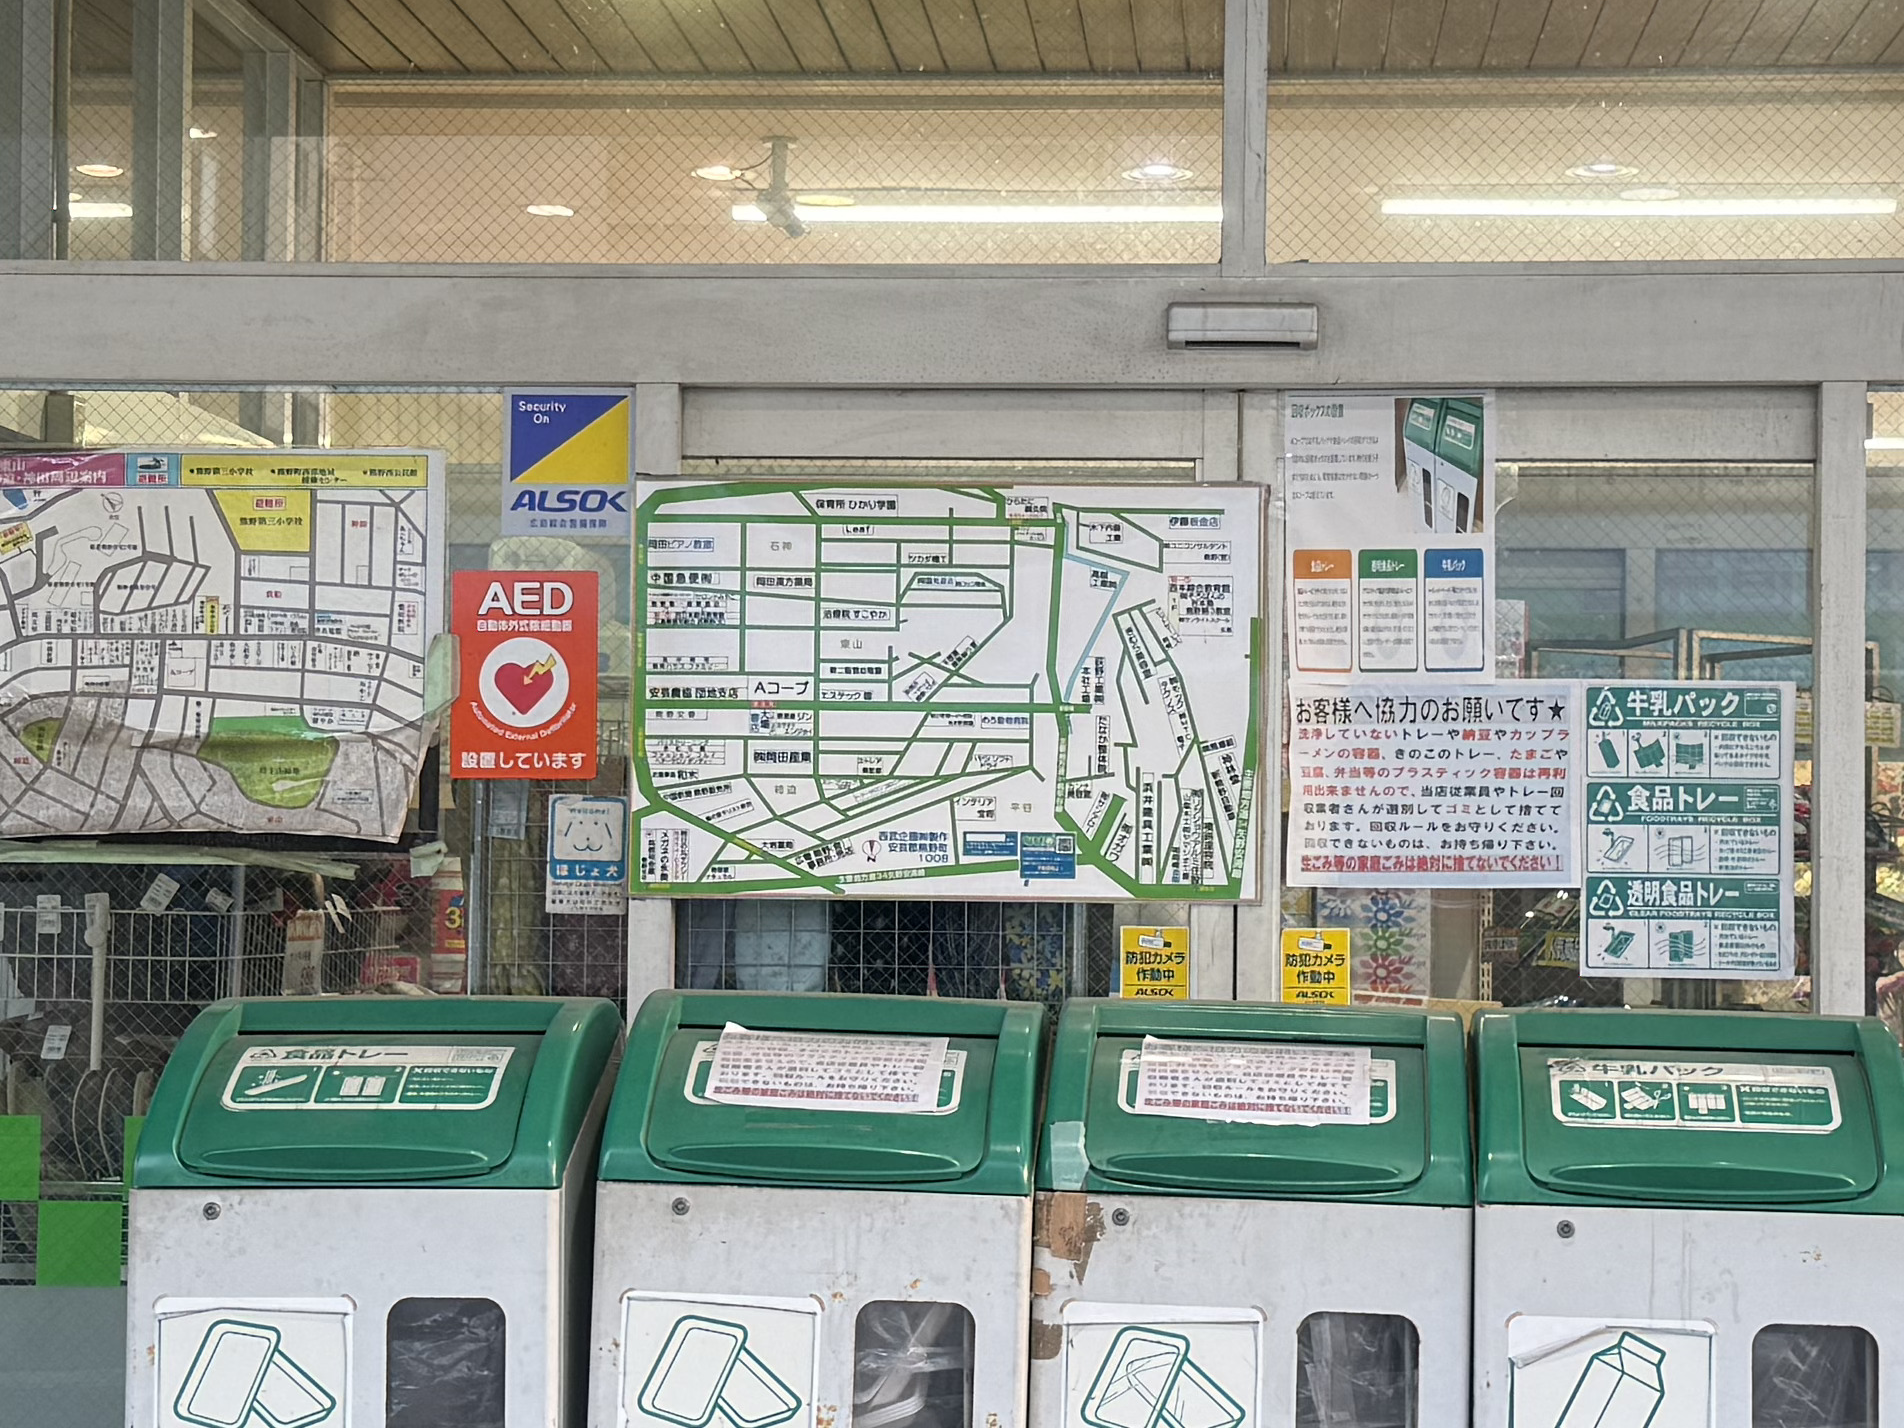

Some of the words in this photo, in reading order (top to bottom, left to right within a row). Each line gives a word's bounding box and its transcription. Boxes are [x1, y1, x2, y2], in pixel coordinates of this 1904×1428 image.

[519, 401, 566, 412] Security
[533, 413, 550, 424] On
[510, 489, 627, 512] ALSOK
[477, 581, 574, 616] AED
[754, 680, 810, 696] Aコープ
[1627, 690, 1740, 717] 牛乳パック
[461, 751, 587, 769] 設置しています
[1627, 785, 1739, 812] 食品トレー
[1627, 879, 1740, 907] 透明食品トレー
[1125, 951, 1186, 966] 防犯カメラ
[1285, 953, 1345, 968] 防犯カメラ
[1136, 968, 1175, 982] 作動中
[1296, 969, 1336, 984] 作動中
[1135, 988, 1174, 997] ALSOK
[1296, 990, 1335, 999] ALSOK
[281, 1048, 409, 1061] 食品トレー
[1592, 1064, 1724, 1077] 牛乳パック
